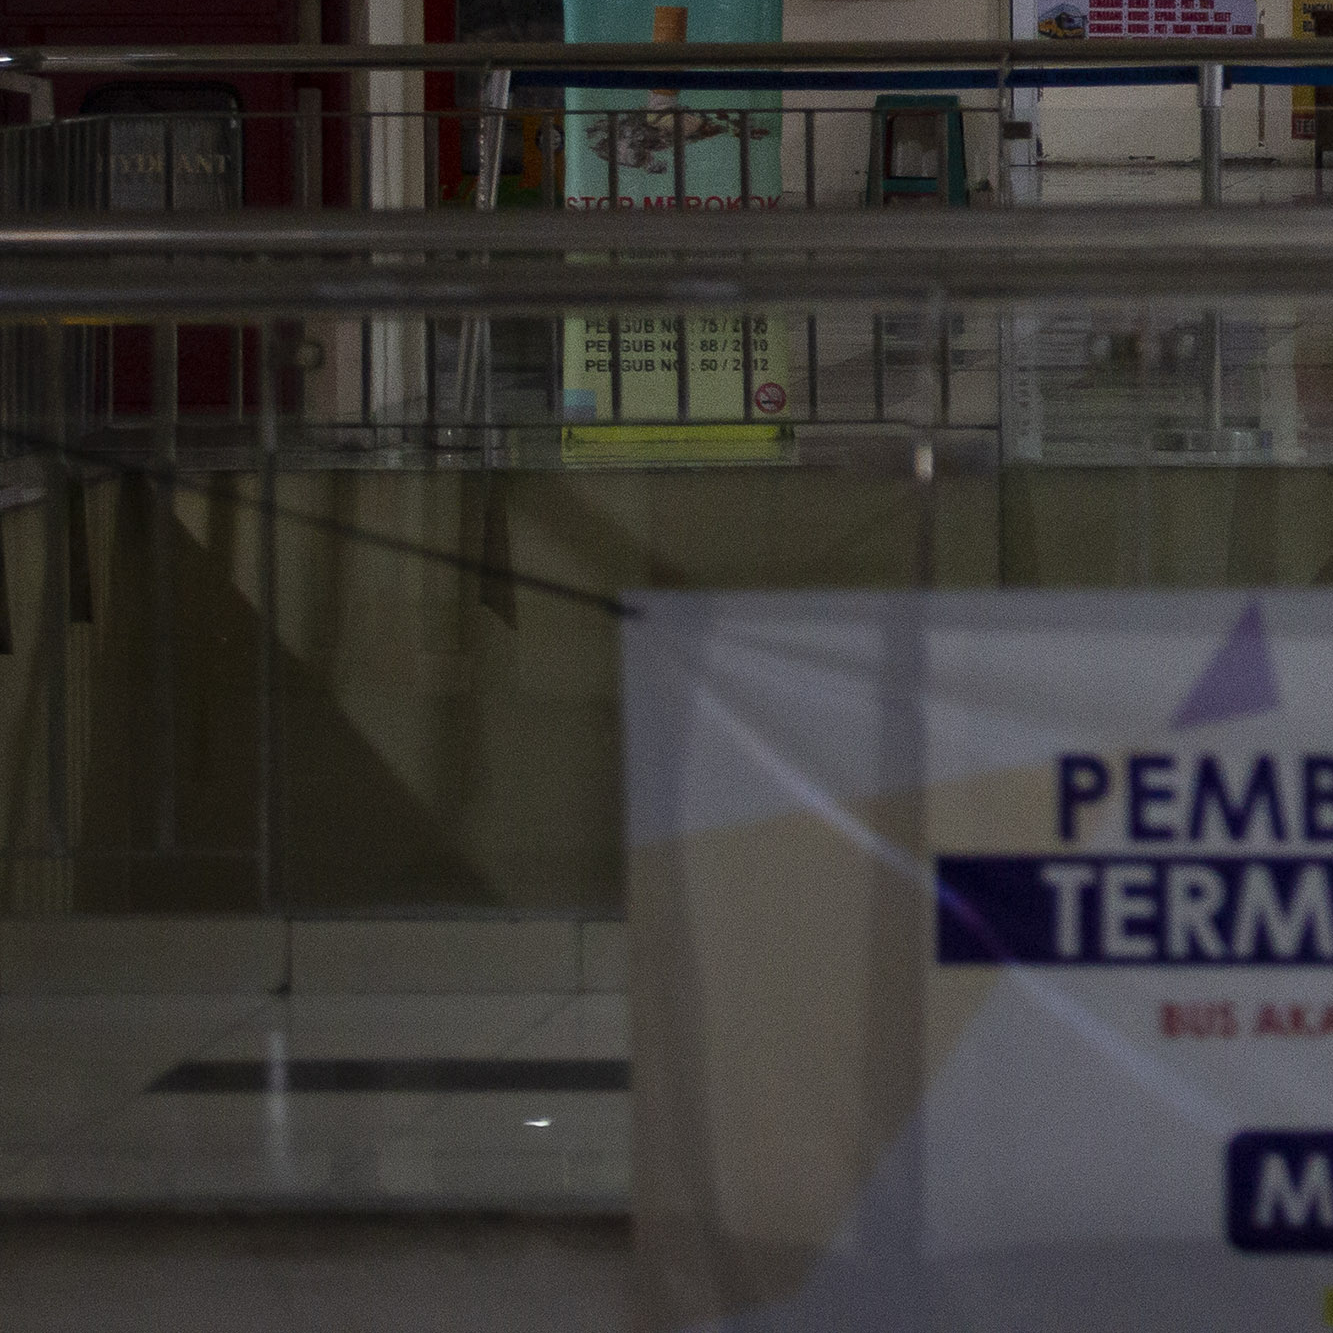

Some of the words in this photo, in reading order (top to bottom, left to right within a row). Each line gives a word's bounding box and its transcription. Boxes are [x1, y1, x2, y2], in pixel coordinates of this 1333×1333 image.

[585, 318, 655, 334] PEGUB
[585, 340, 655, 353] PEGUB
[732, 340, 768, 353] 210
[585, 359, 655, 373] PEGUB
[732, 359, 768, 373] 212
[1157, 999, 1239, 1042] BUS
